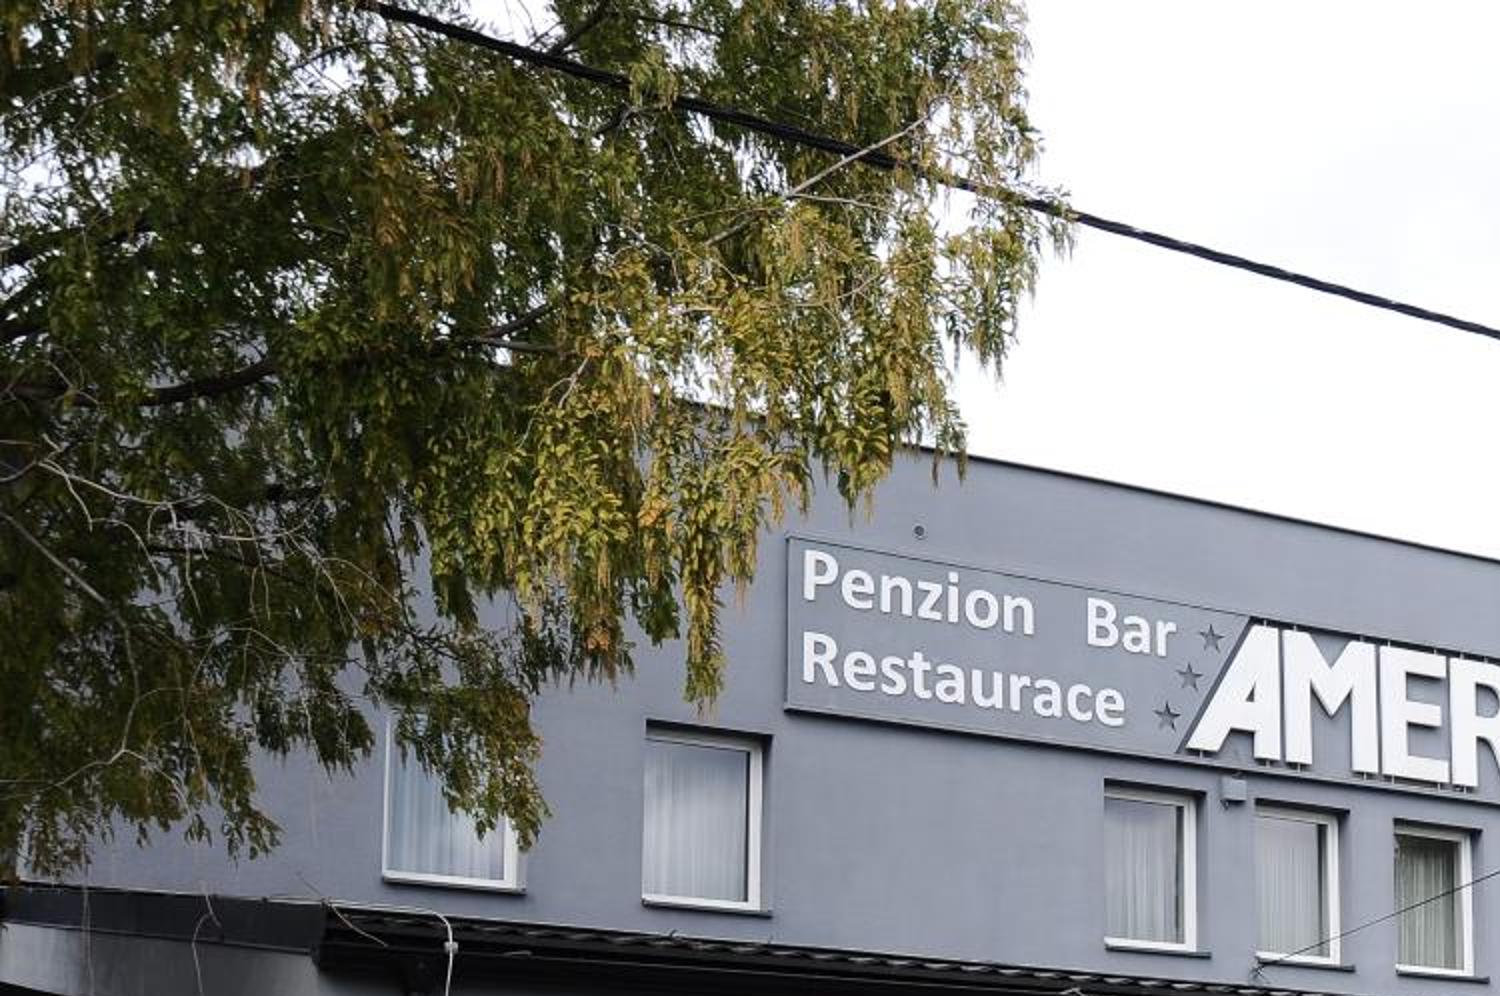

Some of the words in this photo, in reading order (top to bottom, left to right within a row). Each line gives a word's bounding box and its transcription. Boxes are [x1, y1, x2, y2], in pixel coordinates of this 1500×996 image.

[803, 549, 1036, 635] Penzion
[1087, 597, 1178, 657] Bar
[803, 631, 1126, 726] Restaurace
